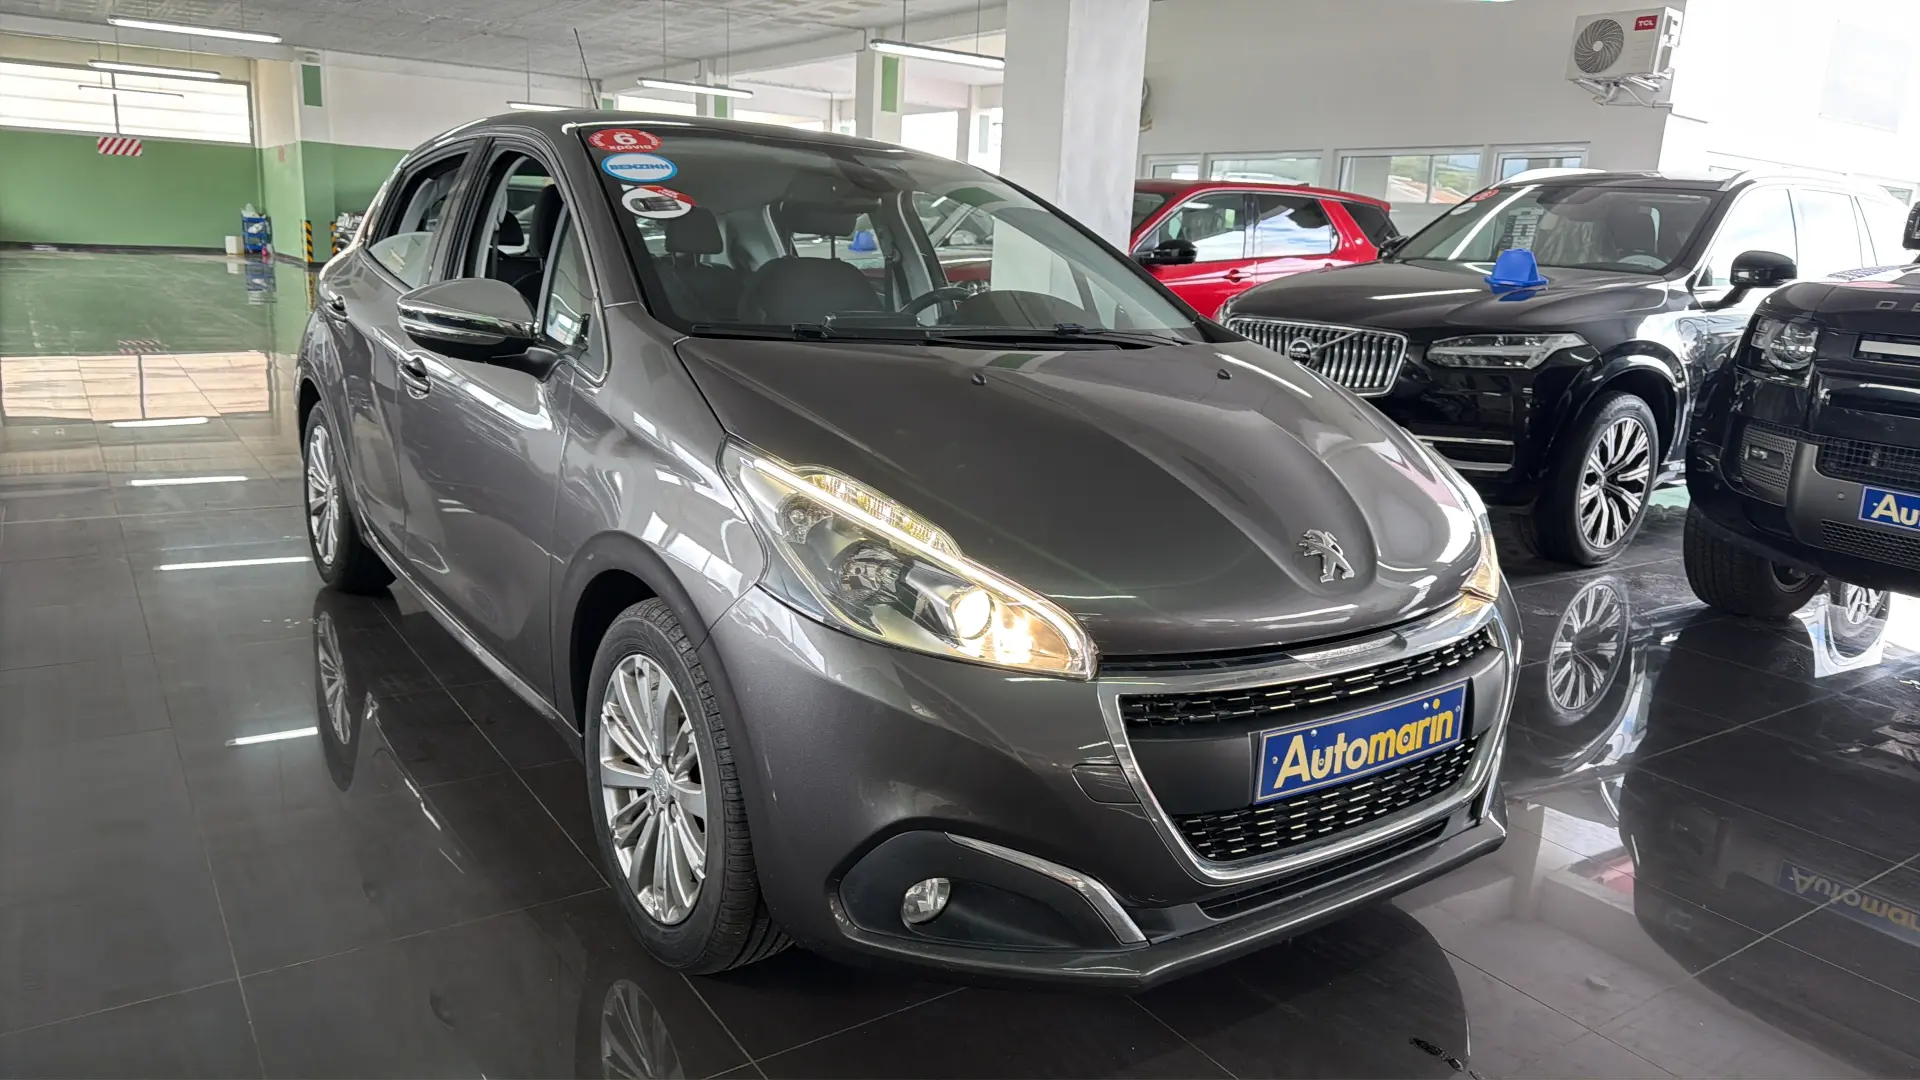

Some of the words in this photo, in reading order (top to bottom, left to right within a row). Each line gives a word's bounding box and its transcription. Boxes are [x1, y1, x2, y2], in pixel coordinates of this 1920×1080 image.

[613, 133, 637, 145] 6
[1870, 493, 1920, 527] Au
[1273, 698, 1454, 789] Automarin
